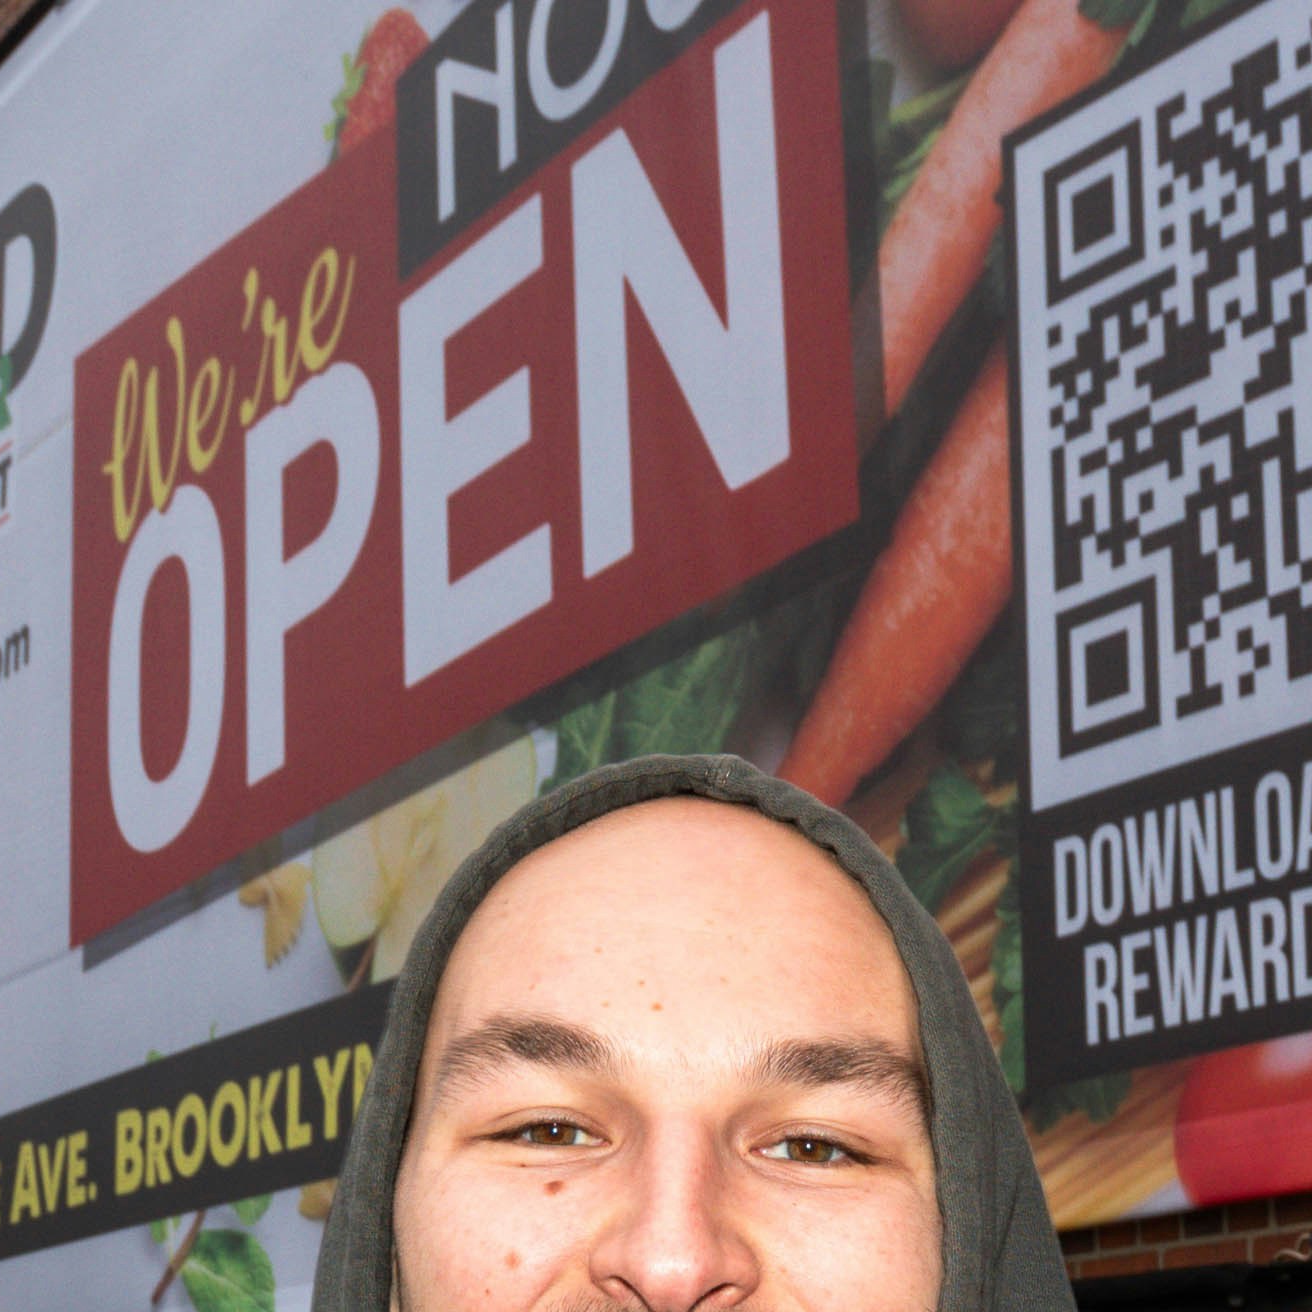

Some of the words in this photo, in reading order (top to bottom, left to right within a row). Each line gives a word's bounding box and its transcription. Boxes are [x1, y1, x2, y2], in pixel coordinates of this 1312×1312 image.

[435, 0, 706, 223] NO
[103, 247, 355, 542] We're
[108, 8, 791, 854] OPEN
[9, 1130, 98, 1225] AVE.
